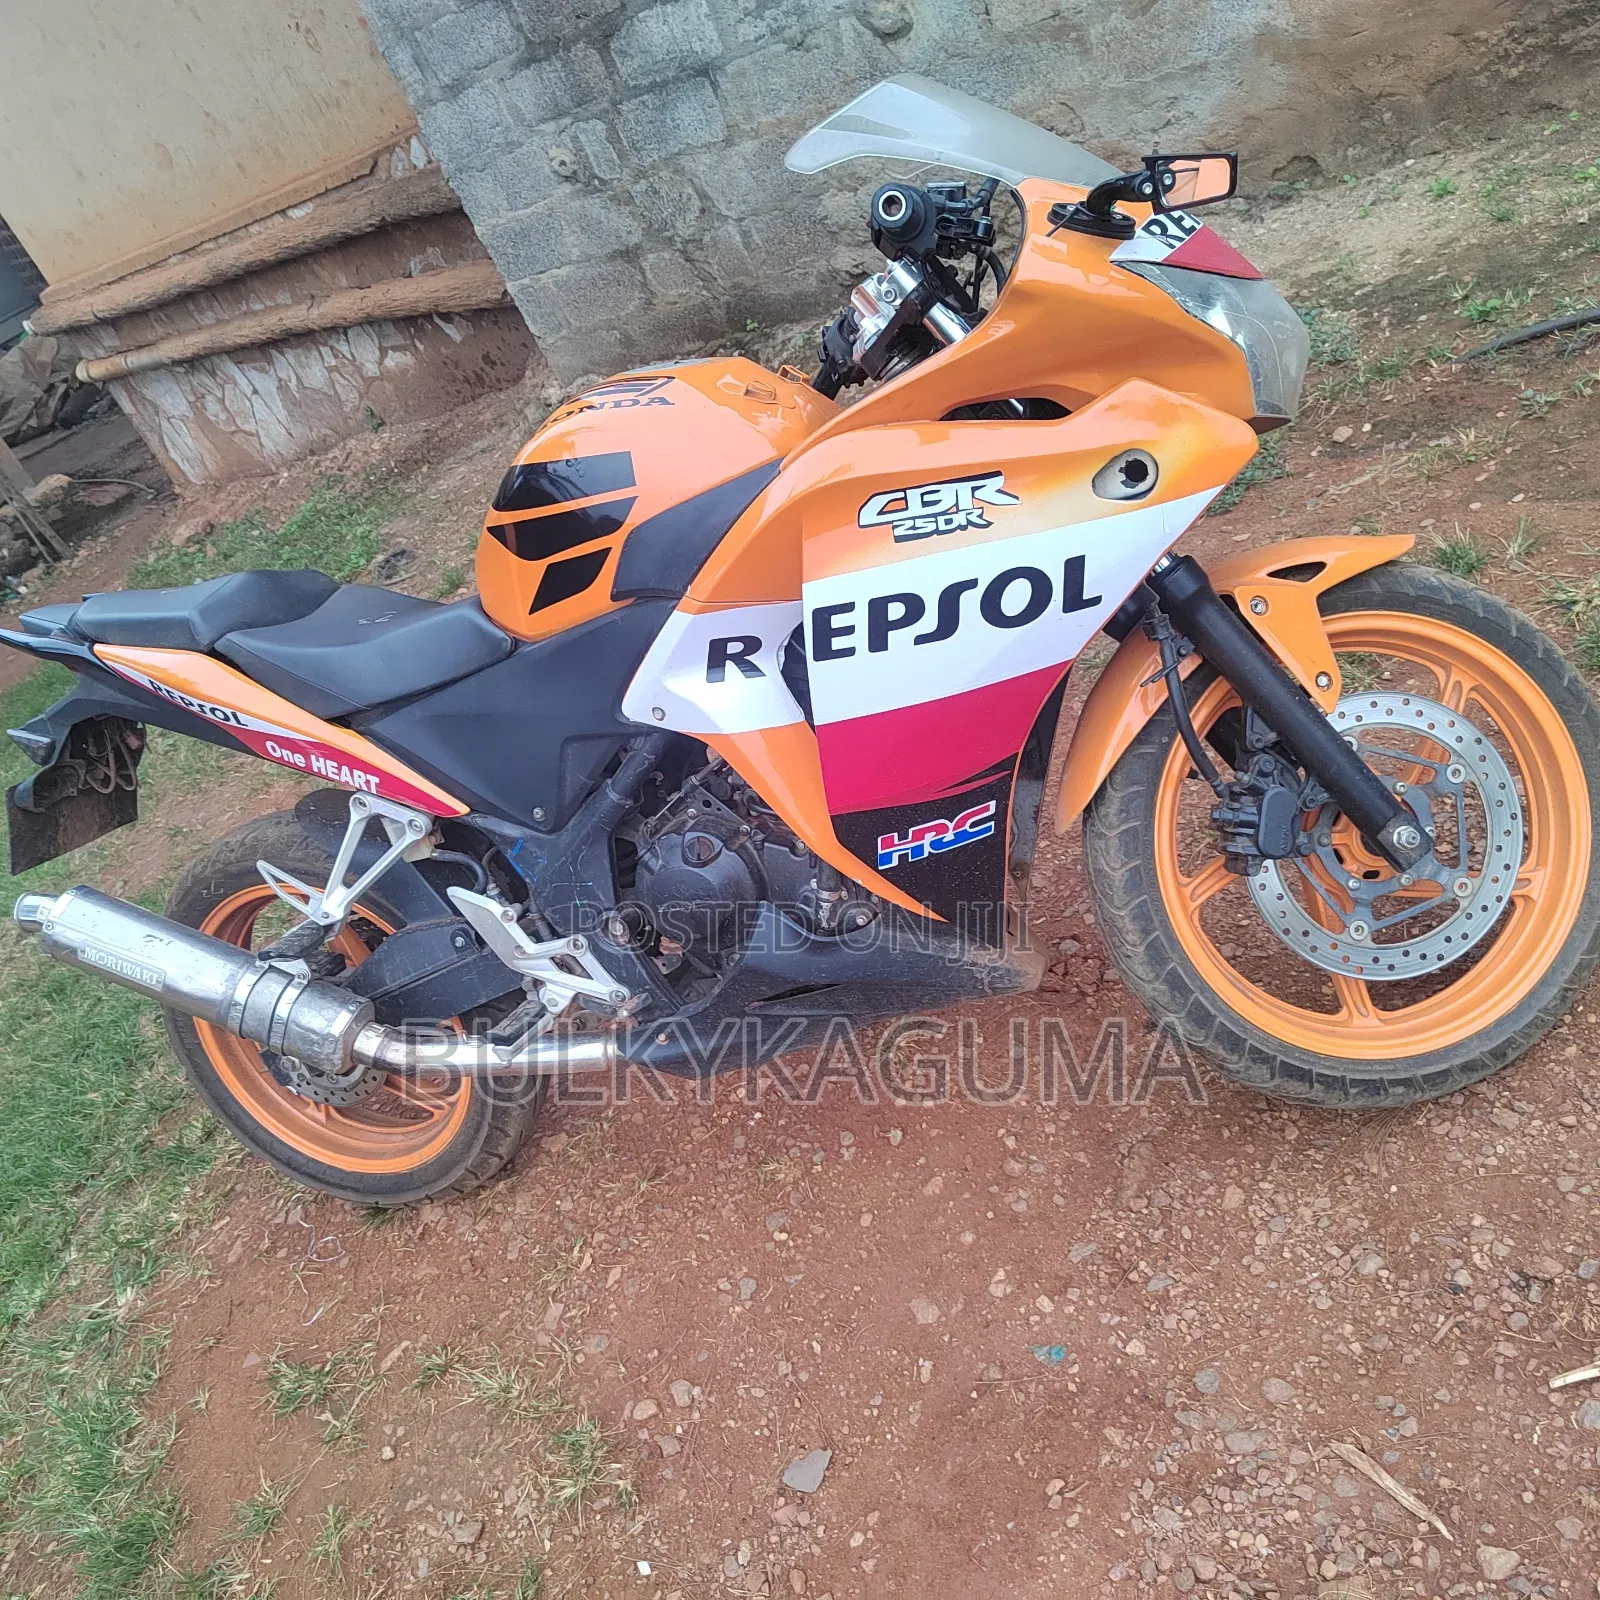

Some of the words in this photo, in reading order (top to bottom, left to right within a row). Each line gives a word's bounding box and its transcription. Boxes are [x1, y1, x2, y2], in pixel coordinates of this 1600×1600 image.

[540, 396, 675, 430] ONDA
[858, 470, 1022, 528] CBR
[148, 678, 249, 728] REPSOL
[265, 740, 306, 767] One
[310, 754, 380, 795] HEART
[878, 800, 996, 870] HRC
[84, 947, 158, 985] MORIWAKI
